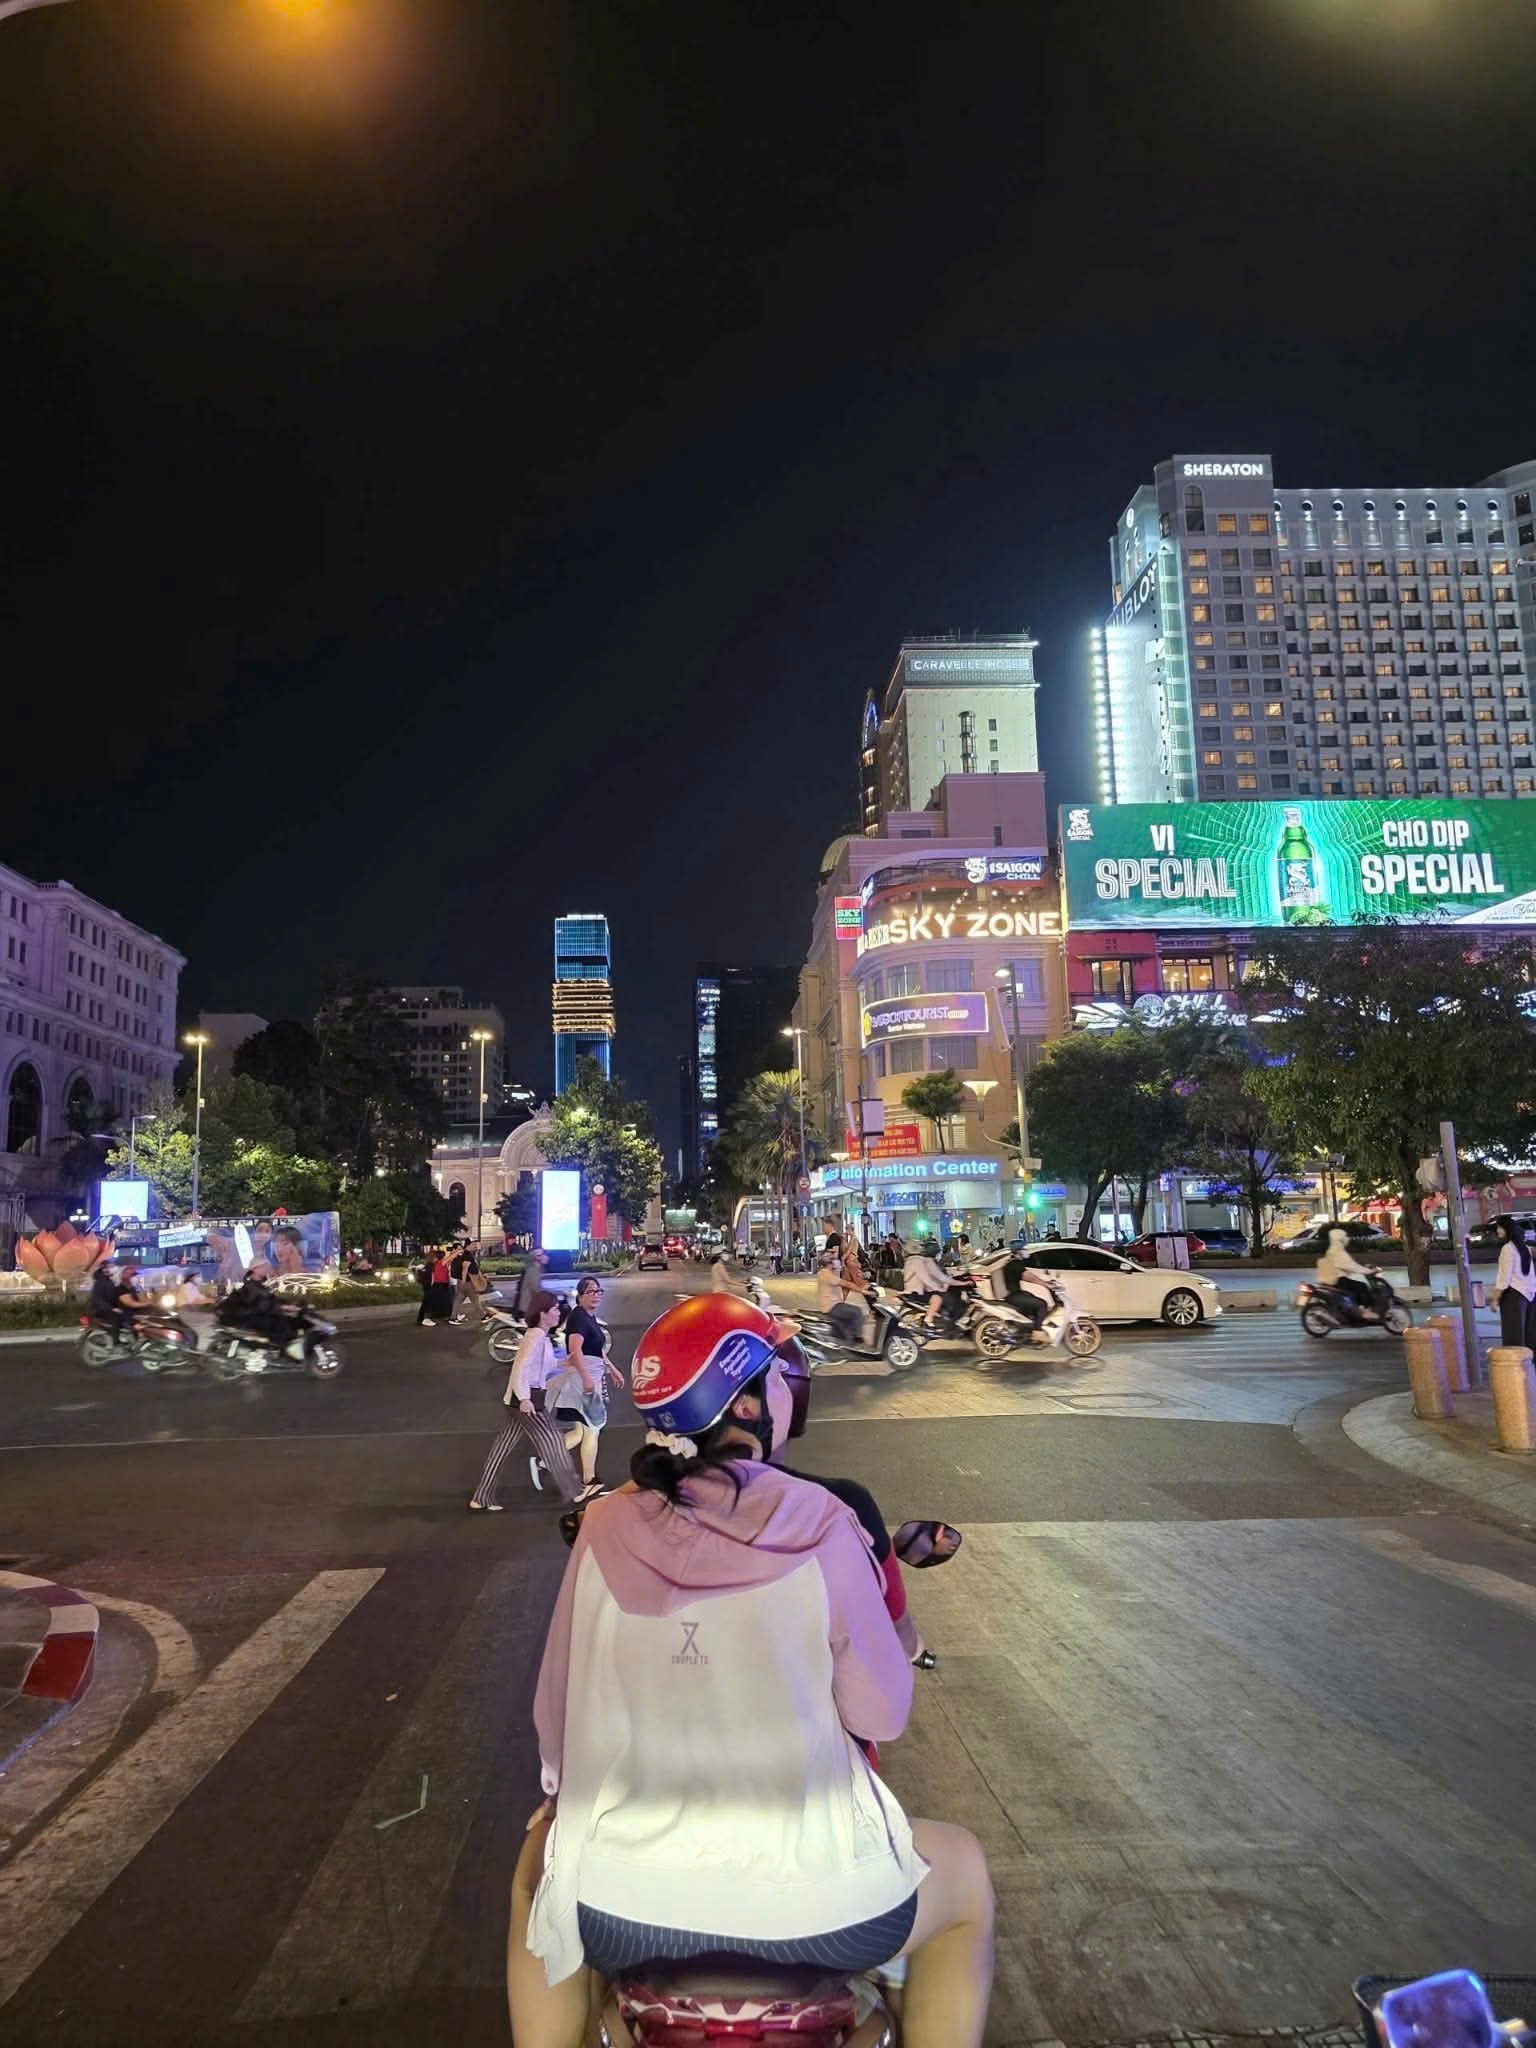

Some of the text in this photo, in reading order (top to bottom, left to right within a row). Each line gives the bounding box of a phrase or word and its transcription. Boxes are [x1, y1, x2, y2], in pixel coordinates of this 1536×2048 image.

[1183, 463, 1263, 476] SHERATON
[913, 660, 983, 671] CARAVELLE
[1149, 824, 1175, 856] VỊ
[1382, 819, 1470, 852] CHO DỊP
[995, 862, 1041, 873] SAIGON
[1006, 873, 1041, 881] CHILL
[1094, 857, 1239, 899] SPECIAL
[1360, 852, 1505, 895] SPECIAL
[889, 911, 1061, 944] SKY ZONE
[932, 1160, 998, 1176] Center
